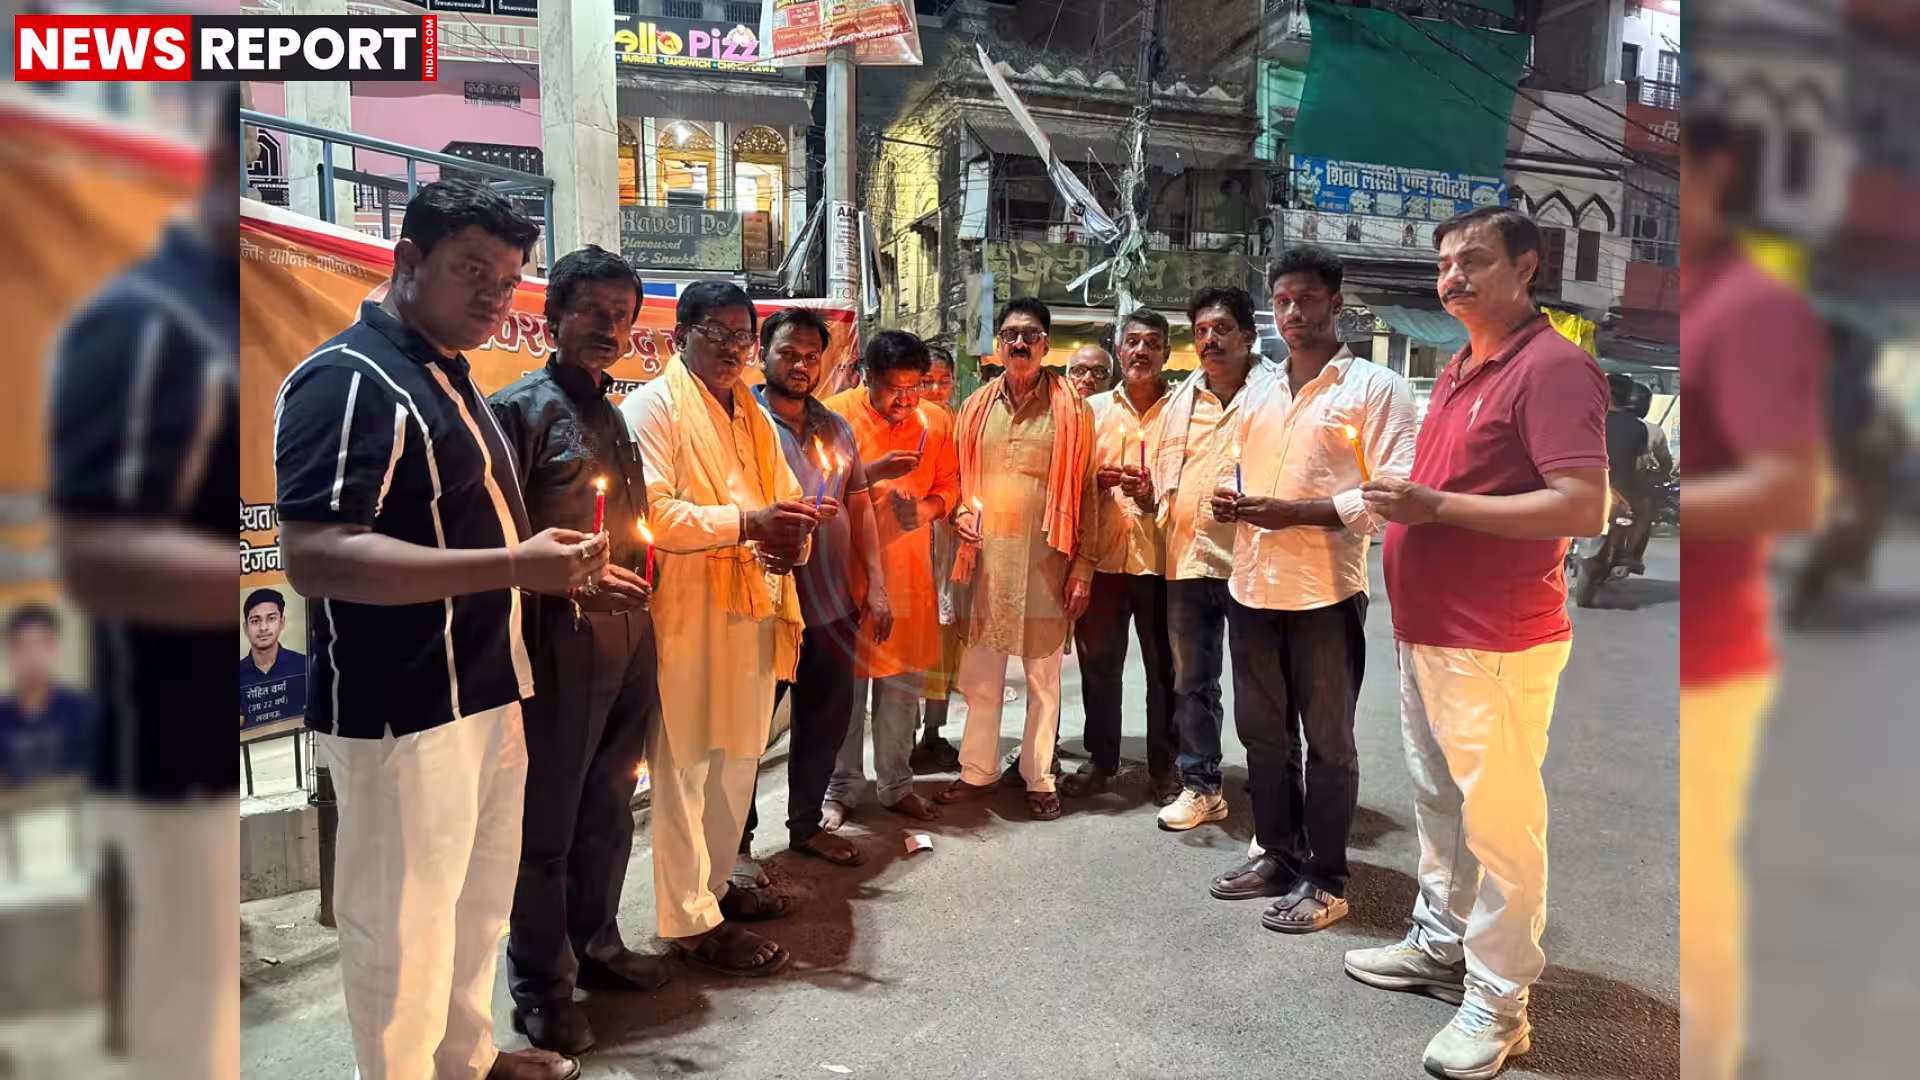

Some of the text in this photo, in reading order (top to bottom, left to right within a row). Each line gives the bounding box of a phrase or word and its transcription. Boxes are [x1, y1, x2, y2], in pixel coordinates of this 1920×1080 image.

[622, 54, 657, 64] BURGER
[664, 58, 711, 69] SANDWICH
[620, 210, 694, 236] Haveli
[263, 701, 272, 709] 22
